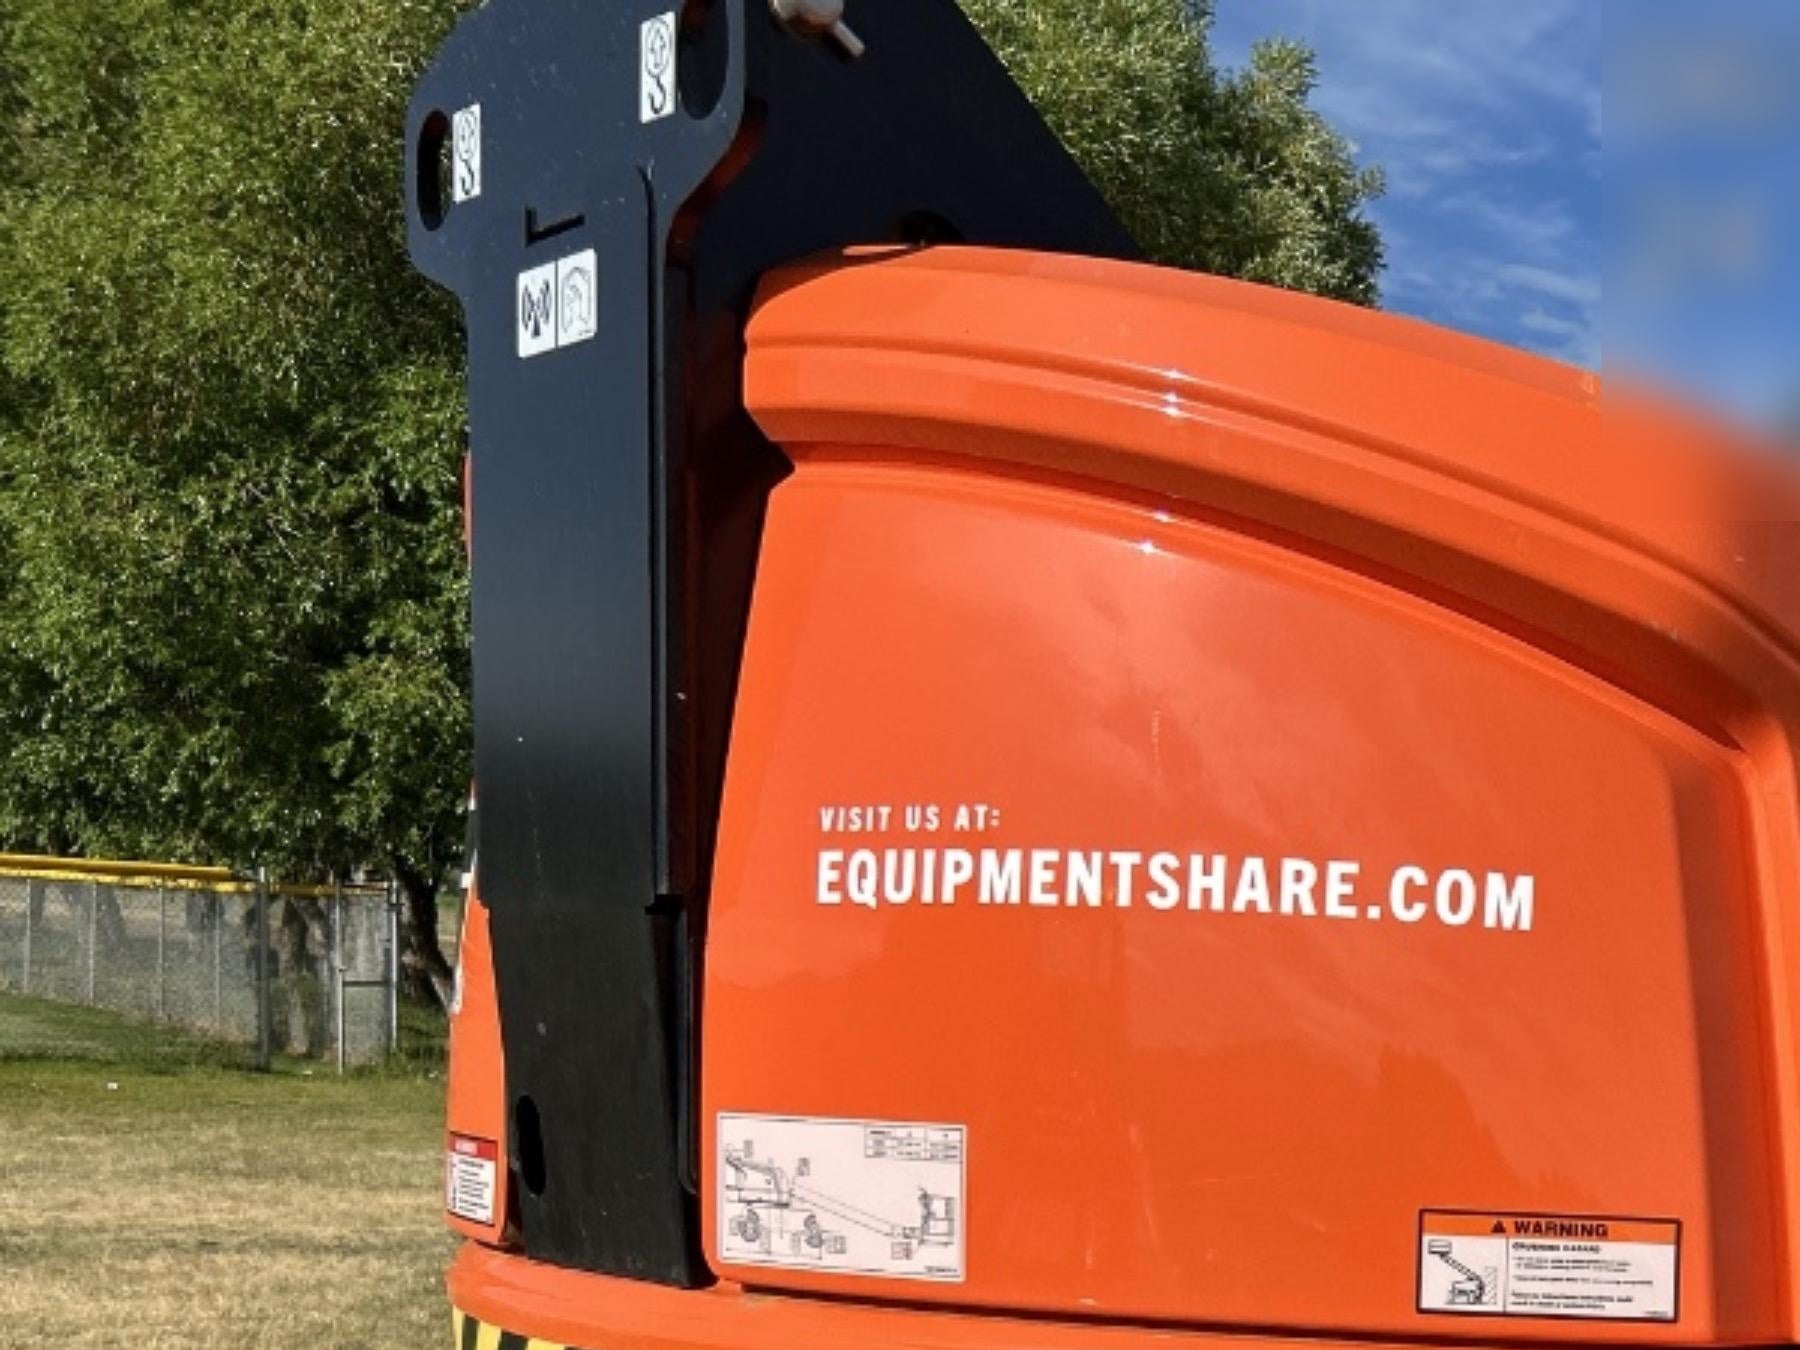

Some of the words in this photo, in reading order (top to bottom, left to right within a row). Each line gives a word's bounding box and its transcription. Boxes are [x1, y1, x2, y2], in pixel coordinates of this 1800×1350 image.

[819, 806, 891, 832] VISIT
[904, 804, 941, 831] US
[953, 803, 1001, 832] AT:
[816, 848, 1535, 932] EQUIPMENTSHARE.COM
[1513, 1220, 1609, 1238] WARNING
